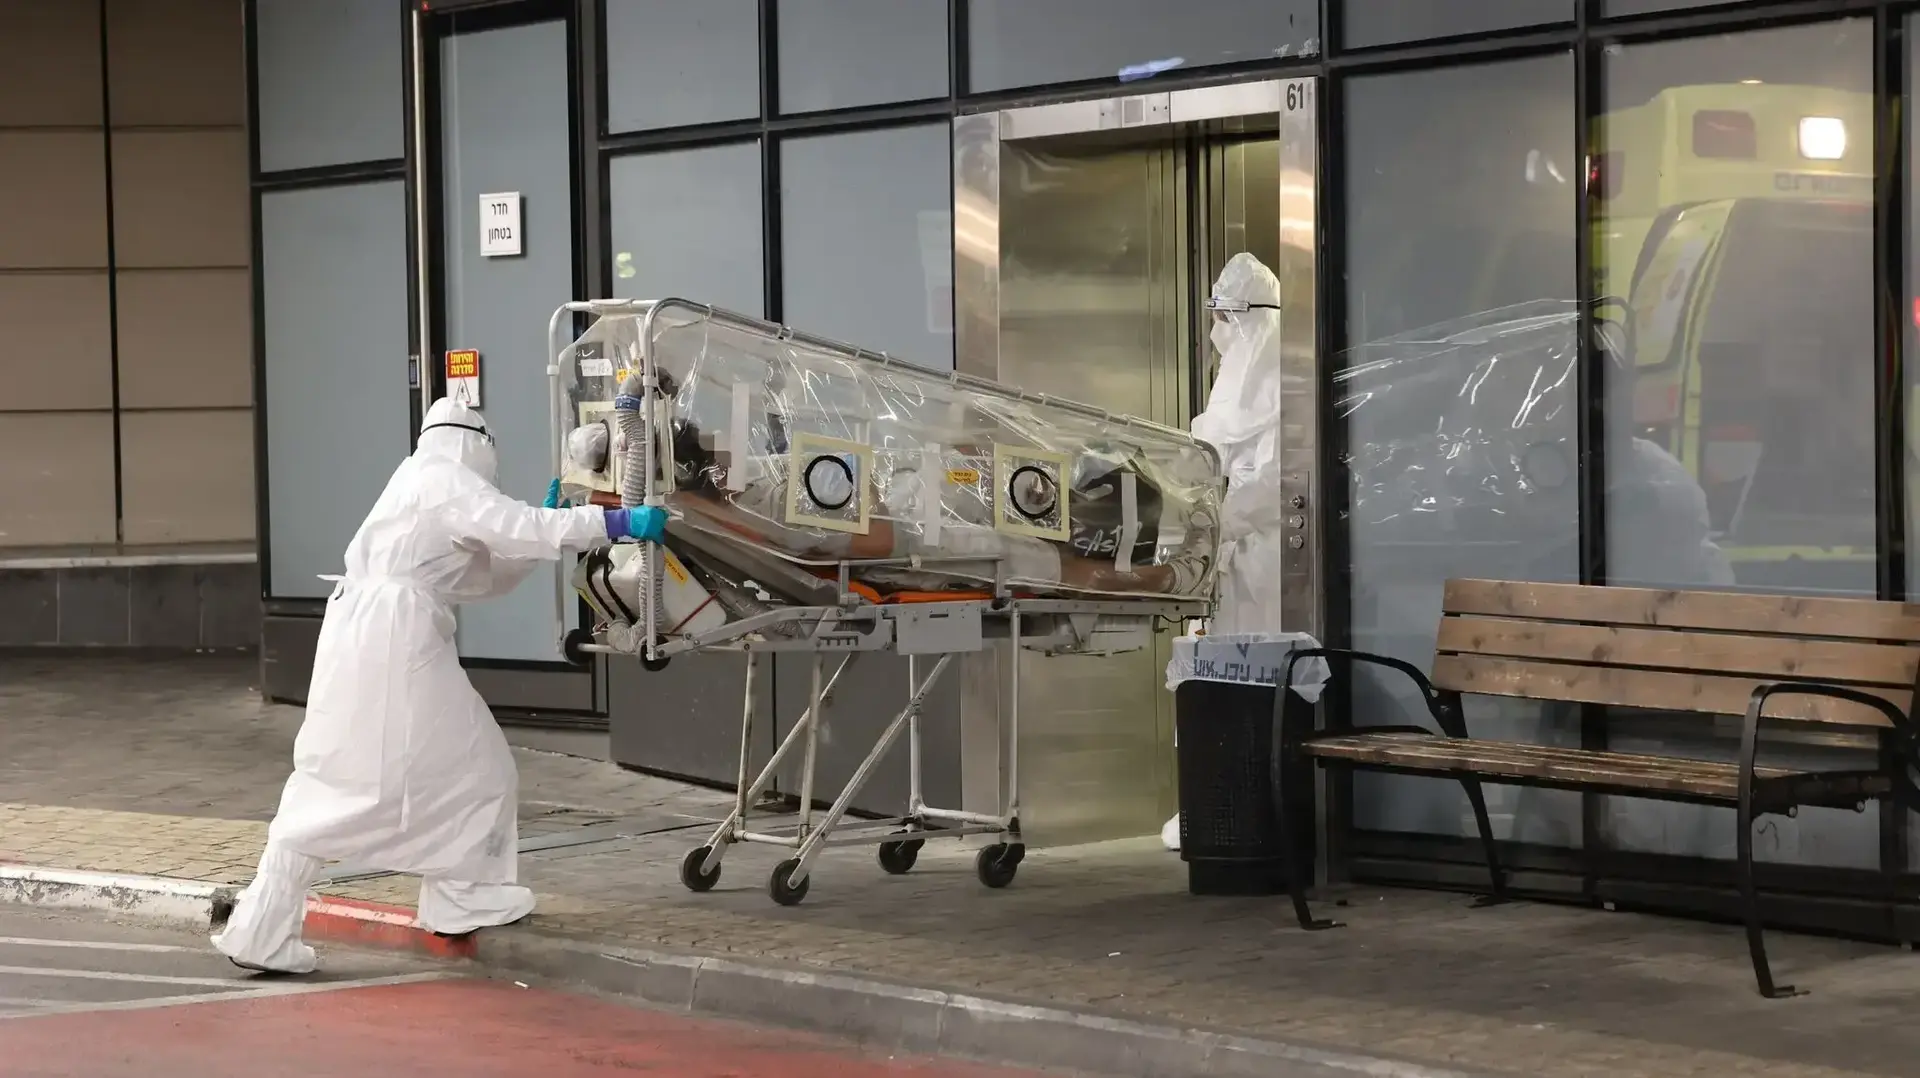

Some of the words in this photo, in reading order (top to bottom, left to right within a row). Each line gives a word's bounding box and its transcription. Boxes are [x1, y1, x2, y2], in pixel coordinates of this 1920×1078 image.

[1287, 82, 1304, 111] 61
[491, 203, 508, 215] חדר
[488, 227, 512, 245] בטחון
